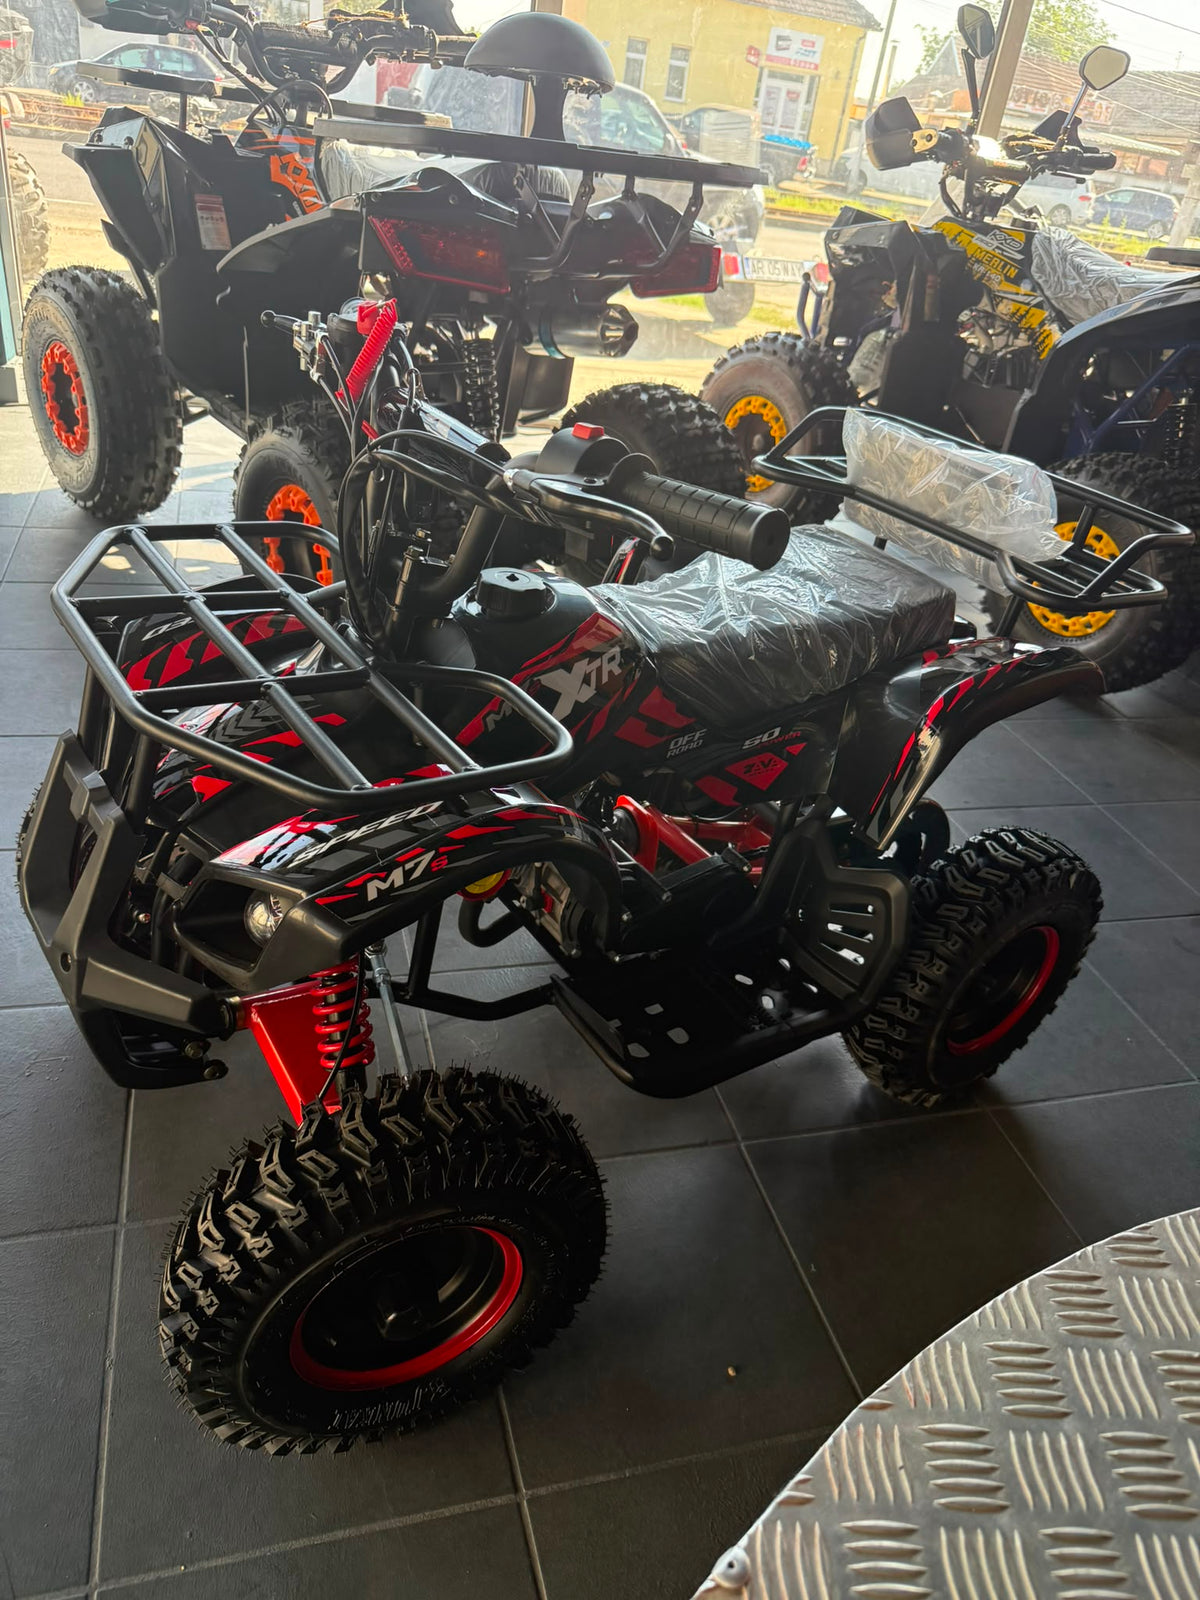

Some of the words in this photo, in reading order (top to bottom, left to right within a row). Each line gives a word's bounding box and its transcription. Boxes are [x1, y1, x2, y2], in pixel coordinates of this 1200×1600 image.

[986, 229, 1025, 251] KXD
[973, 246, 1019, 279] MERLIN
[533, 644, 622, 722] XTR
[666, 739, 704, 759] ROAD
[669, 728, 708, 750] OFF
[286, 800, 445, 869] SPEED
